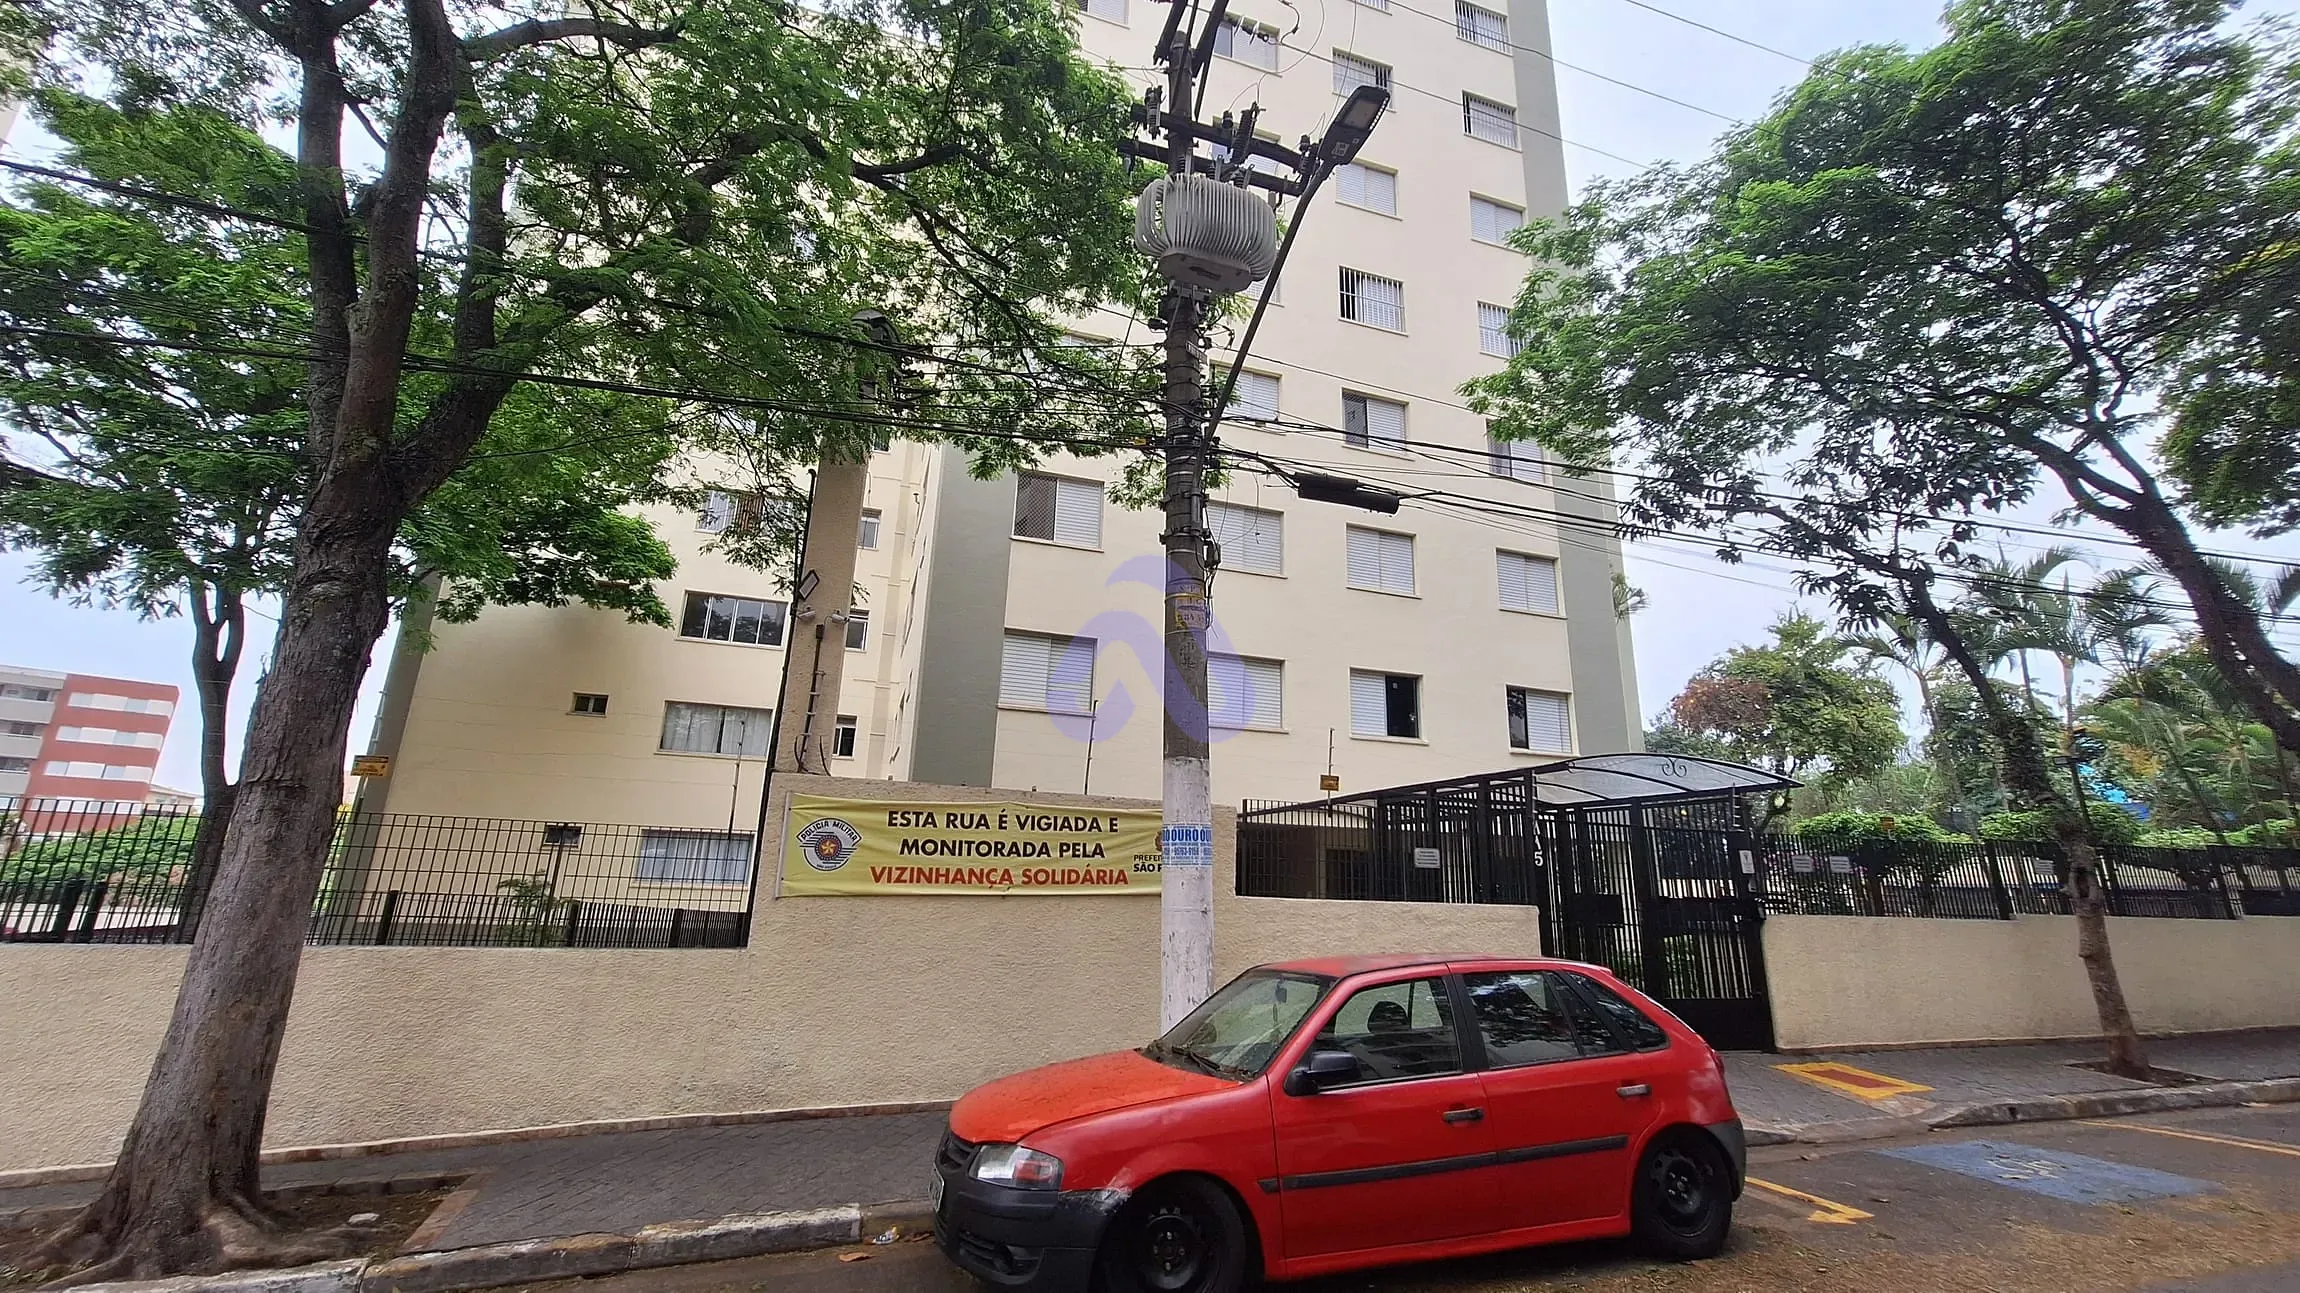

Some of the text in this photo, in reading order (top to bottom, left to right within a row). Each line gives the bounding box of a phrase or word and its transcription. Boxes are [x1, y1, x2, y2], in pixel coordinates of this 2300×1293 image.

[831, 820, 858, 842] MILITAR
[887, 808, 1119, 833] ESTA RUA É VIGIADA E
[1171, 828, 1199, 842] OURO
[899, 838, 1106, 859] MONITORADA PELA
[870, 865, 1015, 889] VIZINHANÇA
[1021, 863, 1129, 886] SOLIDÁRIA
[1133, 861, 1156, 873] SÃO
